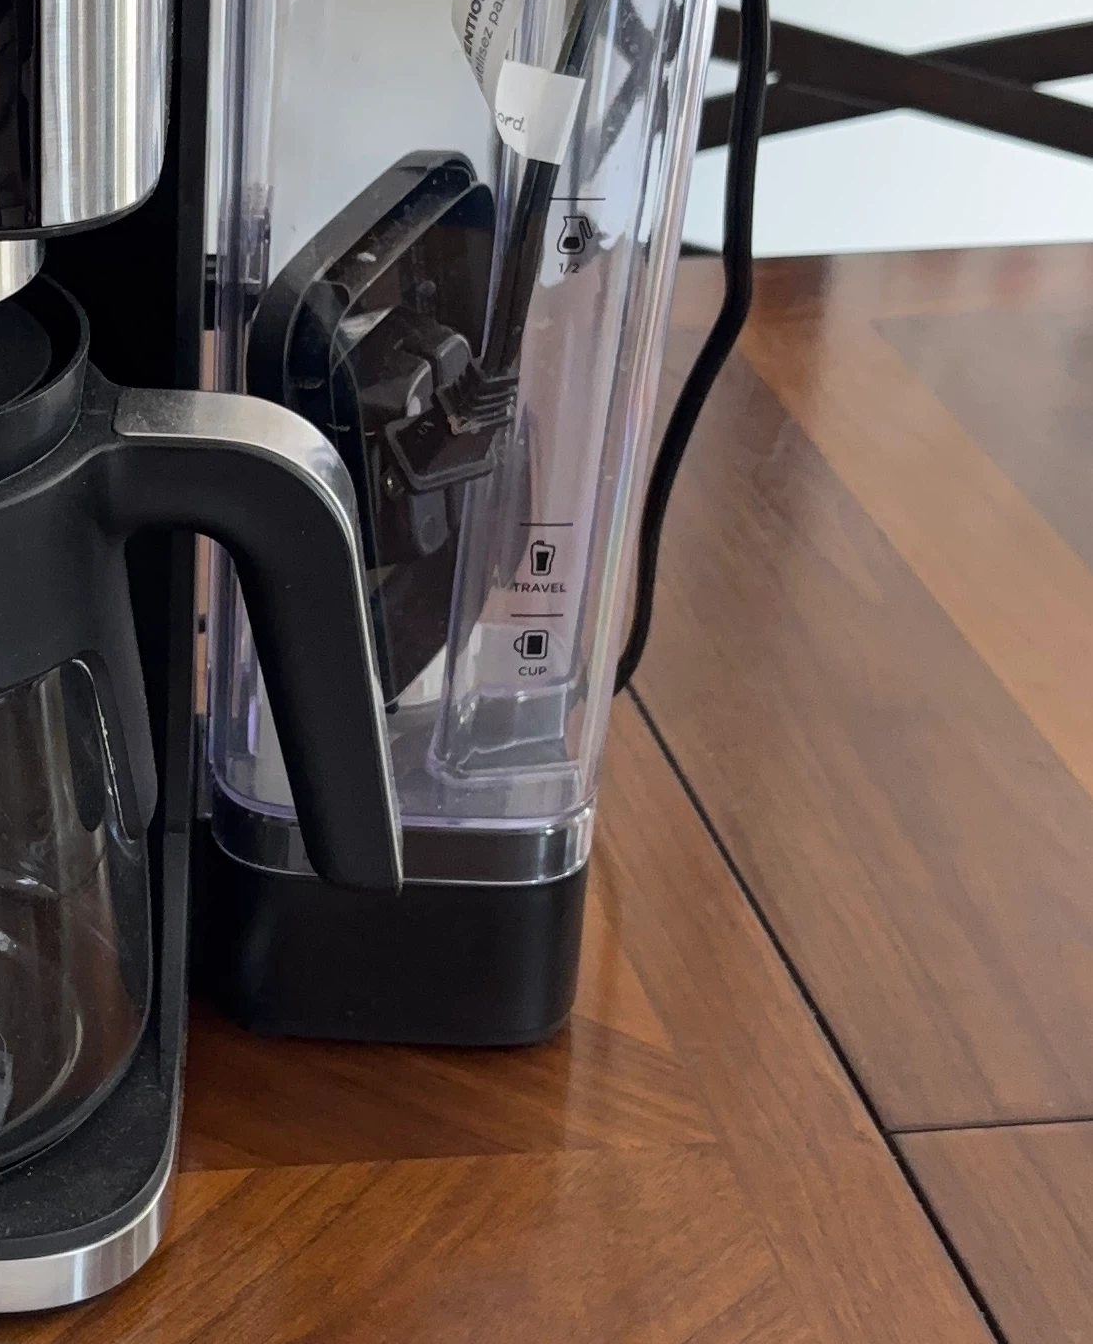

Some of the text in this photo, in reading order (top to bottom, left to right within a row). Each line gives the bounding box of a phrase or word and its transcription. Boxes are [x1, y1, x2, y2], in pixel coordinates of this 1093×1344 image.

[558, 263, 580, 274] 1/2
[512, 582, 567, 593] TRAVEL
[518, 665, 547, 677] CUP
